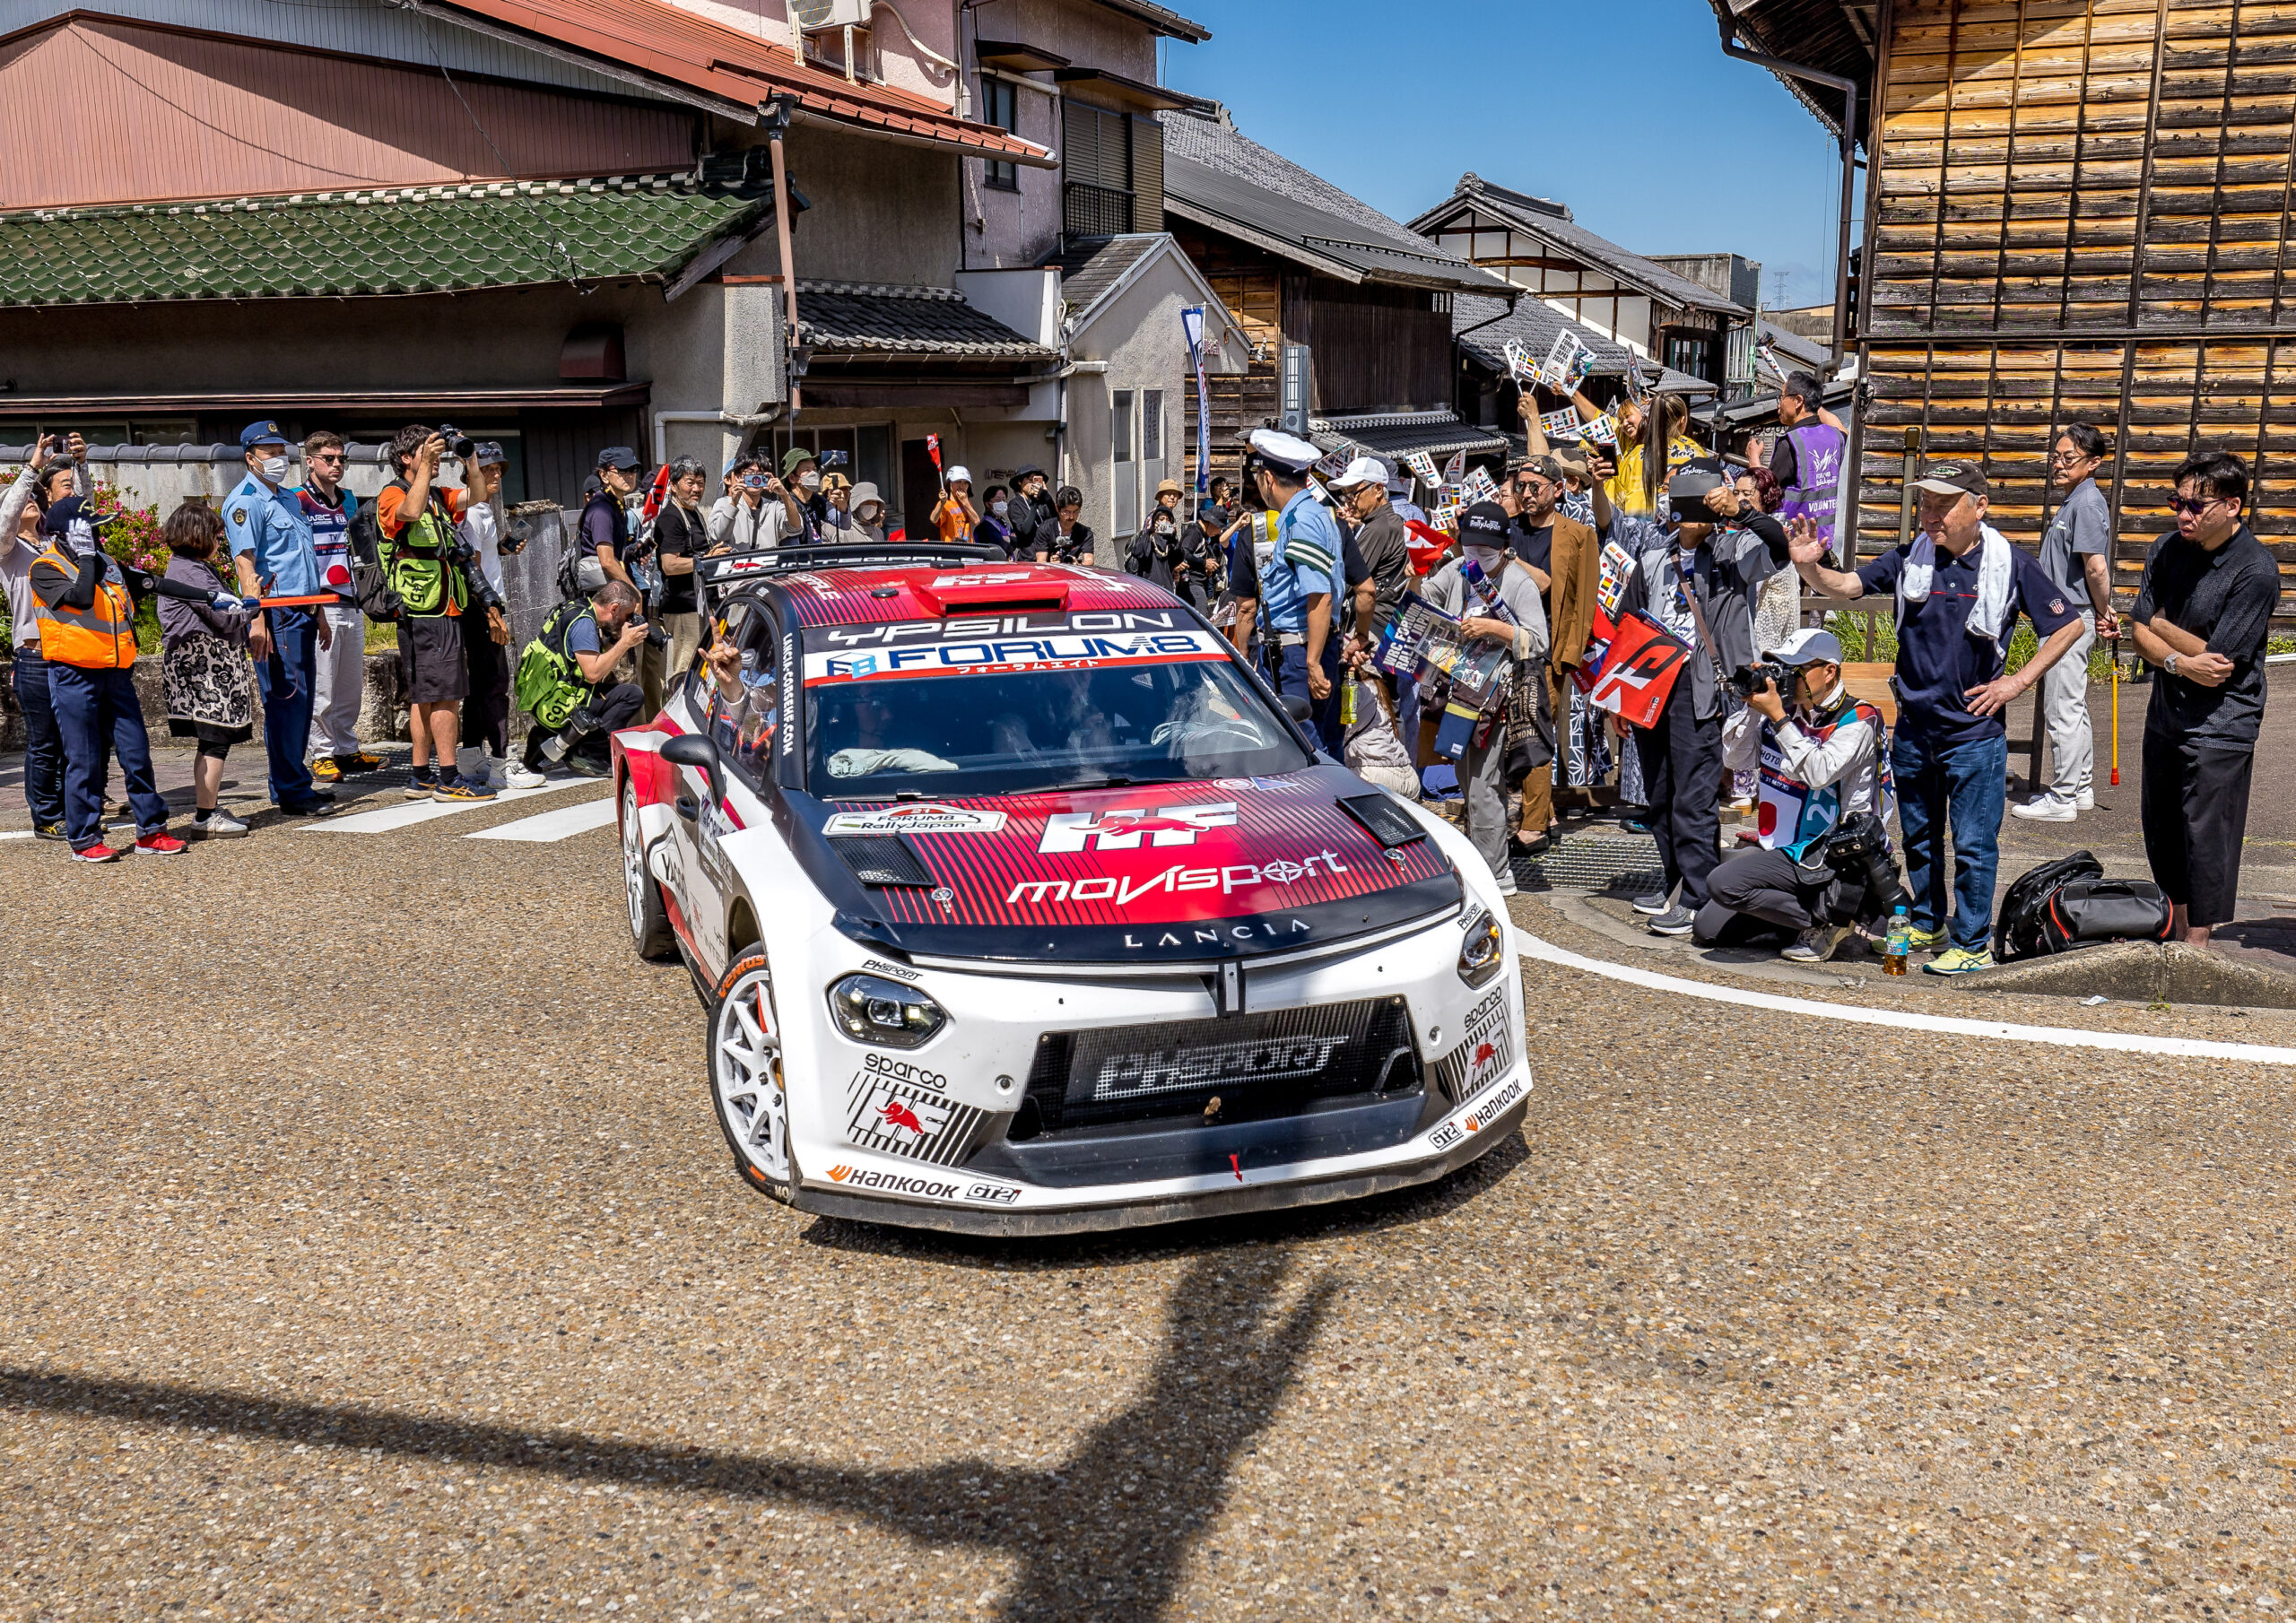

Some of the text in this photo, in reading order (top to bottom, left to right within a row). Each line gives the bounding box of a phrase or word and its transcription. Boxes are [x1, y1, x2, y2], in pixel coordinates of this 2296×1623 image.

[307, 514, 332, 522] WRC
[328, 534, 338, 542] TV
[827, 612, 1174, 646] YPSILON
[1382, 601, 1423, 666] WRC FORUM8
[891, 635, 1200, 670] FORUM8
[956, 658, 1100, 675] フォーラムエイト
[1394, 635, 1418, 671] RALLY
[545, 698, 570, 724] 165
[860, 821, 965, 829] RallyJapan
[1038, 802, 1238, 854] HF
[1125, 919, 1310, 948] LANCIA
[861, 959, 924, 981] PHSPORT
[1464, 985, 1502, 1030] sparco
[864, 1052, 947, 1090] sparco
